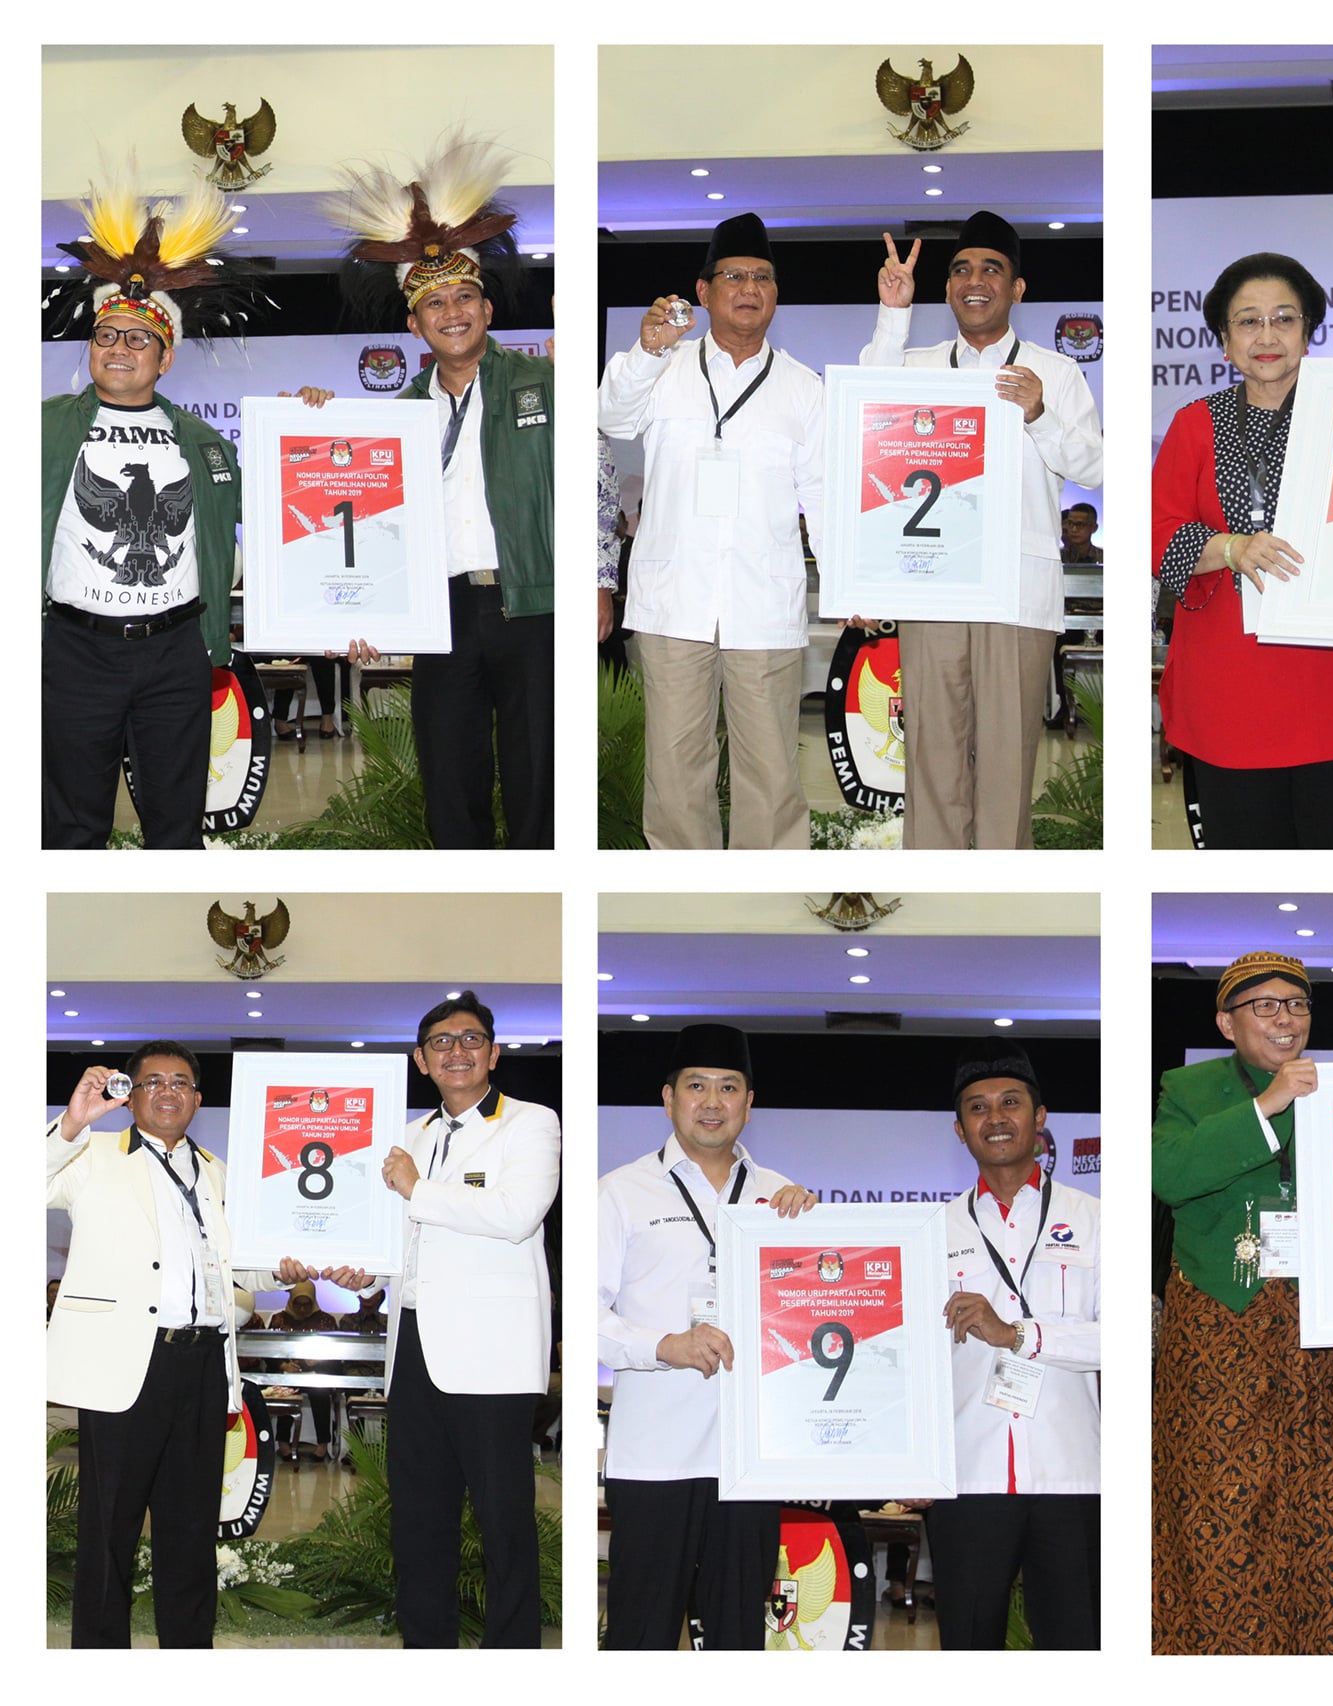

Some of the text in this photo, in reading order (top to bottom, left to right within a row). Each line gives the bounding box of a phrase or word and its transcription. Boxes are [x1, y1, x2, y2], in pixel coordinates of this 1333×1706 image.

[517, 415, 548, 428] PKB
[85, 426, 177, 445] DAMN
[212, 472, 233, 484] PKB
[903, 470, 941, 537] 2
[334, 501, 354, 568] 1
[84, 586, 184, 606] INDONESIA
[829, 731, 905, 811] PEMILIHA
[298, 1142, 333, 1200] 8
[866, 1262, 889, 1271] KPU
[778, 1289, 886, 1297] NOMOR URUT PARTAI POLITIK
[781, 1299, 814, 1307] PESERTA
[816, 1299, 859, 1307] PEMILIHAN
[811, 1322, 854, 1401] 9
[231, 1474, 270, 1536] UMUM
